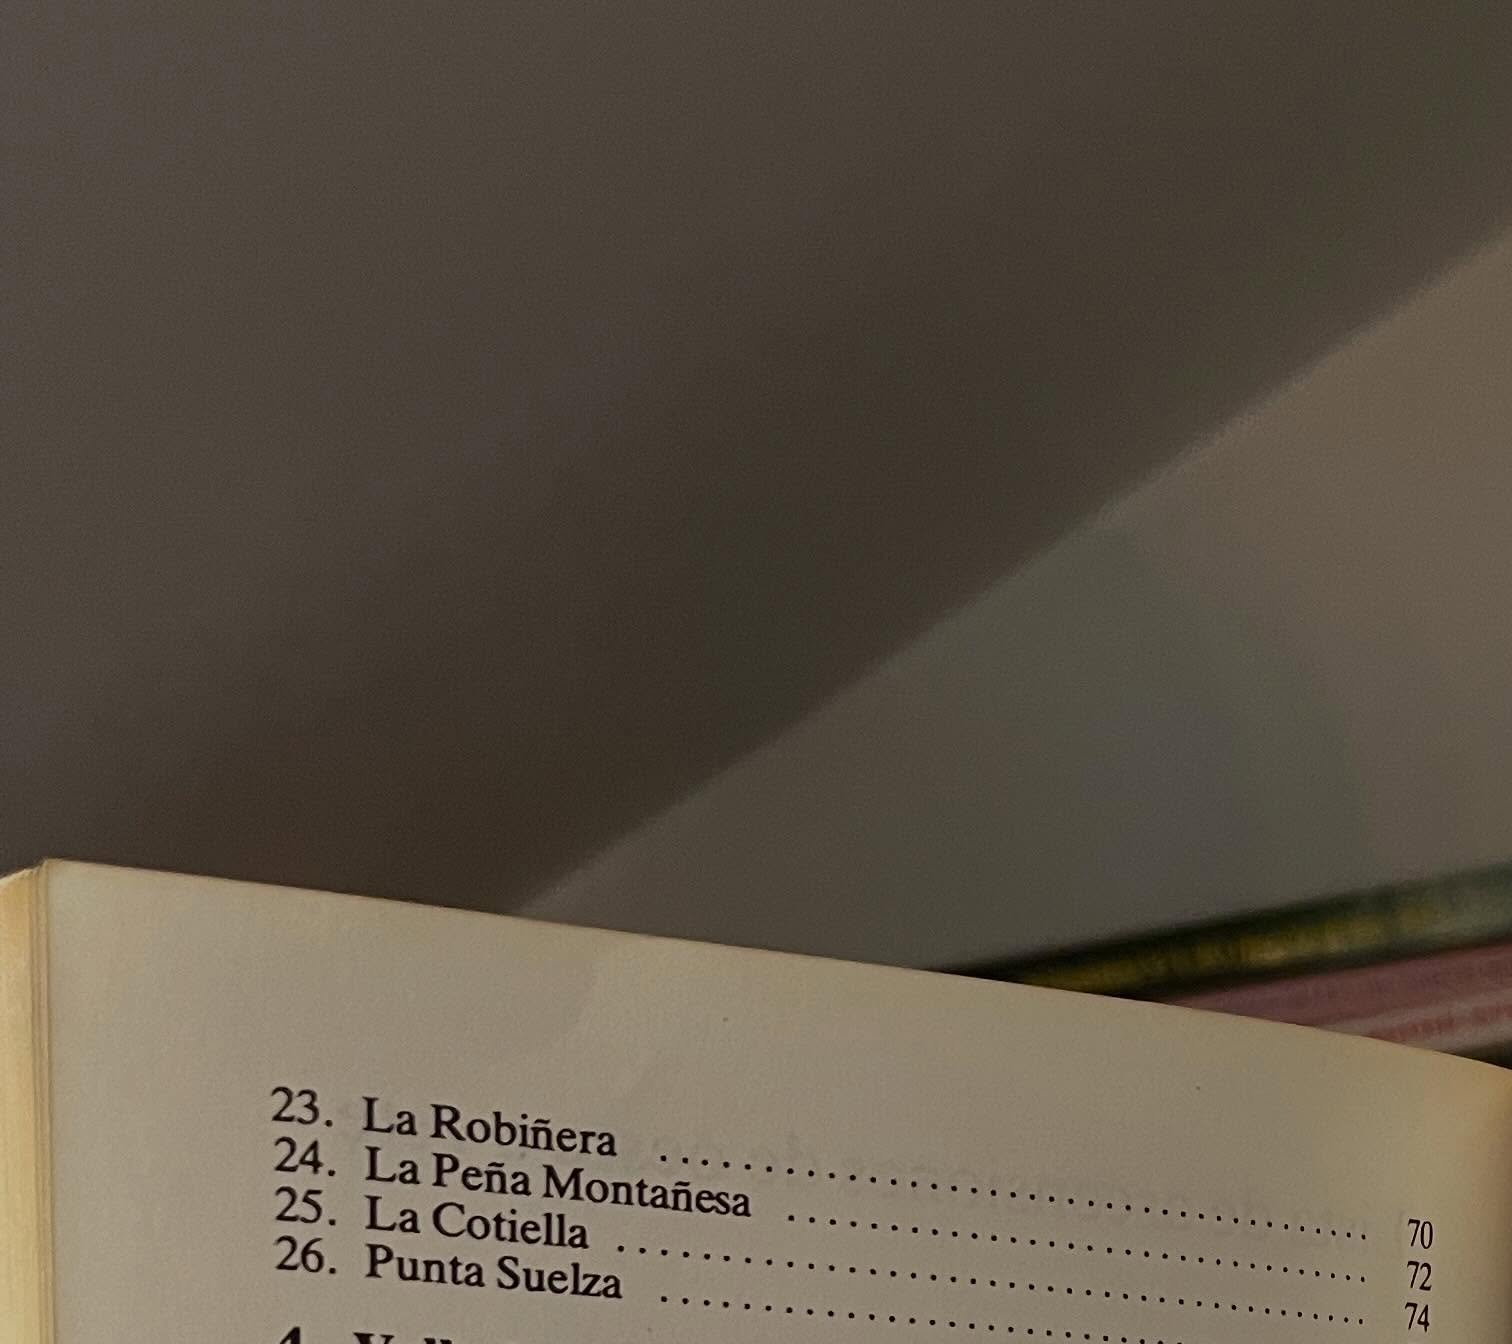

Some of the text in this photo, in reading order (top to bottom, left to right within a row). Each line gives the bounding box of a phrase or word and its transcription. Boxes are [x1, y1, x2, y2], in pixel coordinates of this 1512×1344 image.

[270, 1086, 1434, 1250] 23. La Robiñera 70
[273, 1135, 1433, 1292] 24. La Peña Montañesa 72
